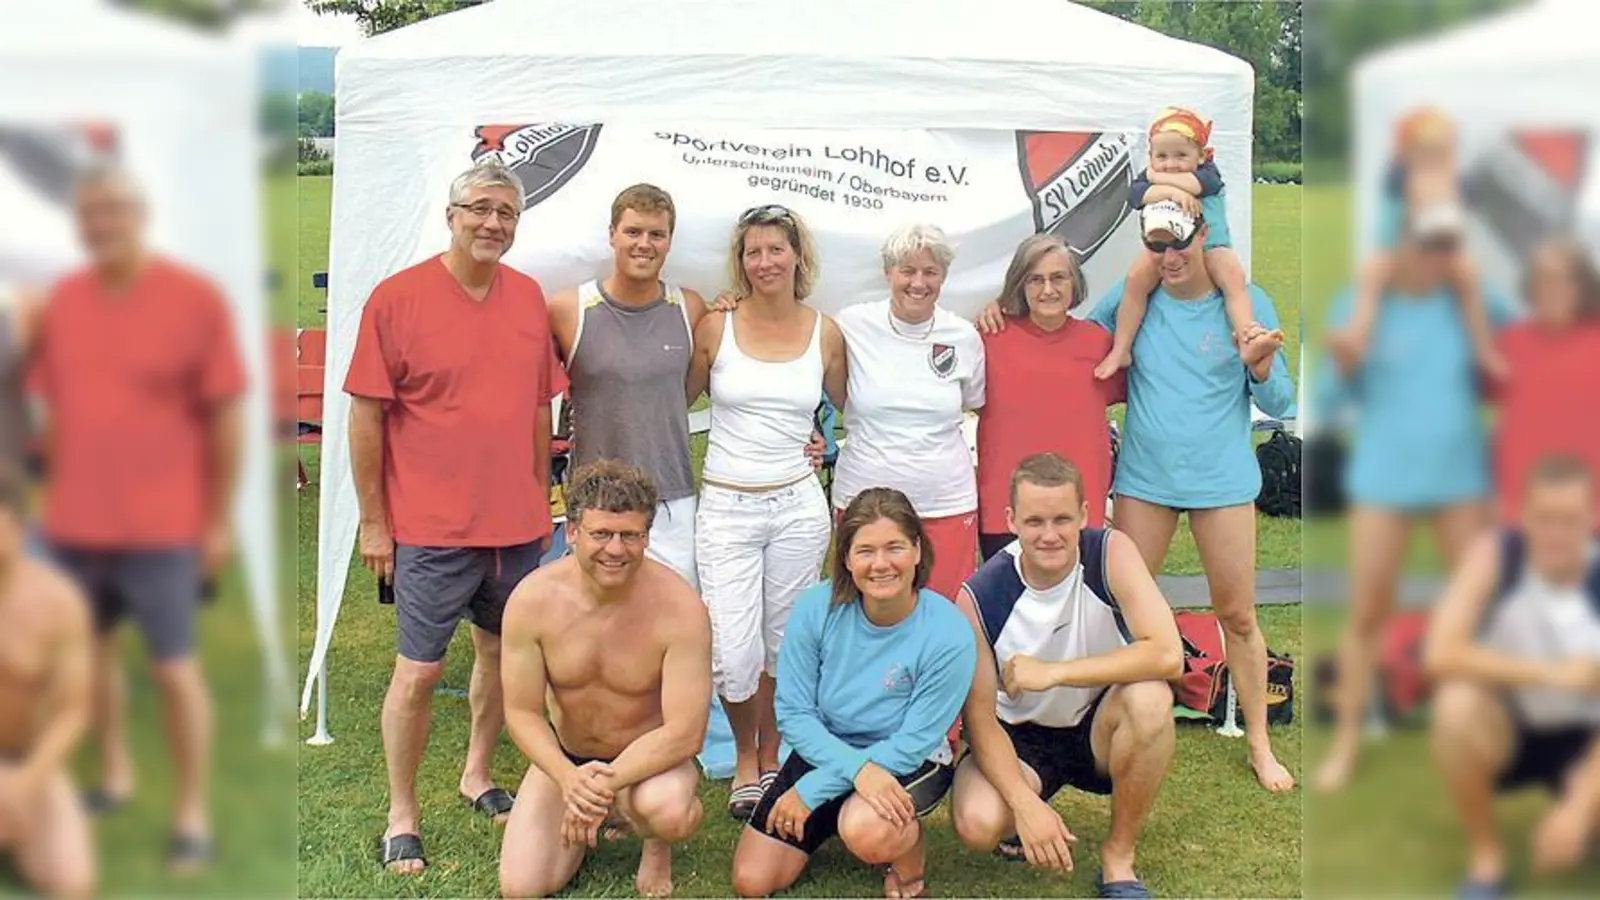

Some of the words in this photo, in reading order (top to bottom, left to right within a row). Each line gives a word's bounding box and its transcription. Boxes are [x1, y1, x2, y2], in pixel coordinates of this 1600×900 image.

[825, 145, 916, 179] Lohhof
[925, 164, 970, 186] e.V.
[747, 175, 835, 204] gegründet
[842, 194, 884, 210] 1930
[850, 175, 949, 202] Oberbayern
[1044, 182, 1069, 219] SV
